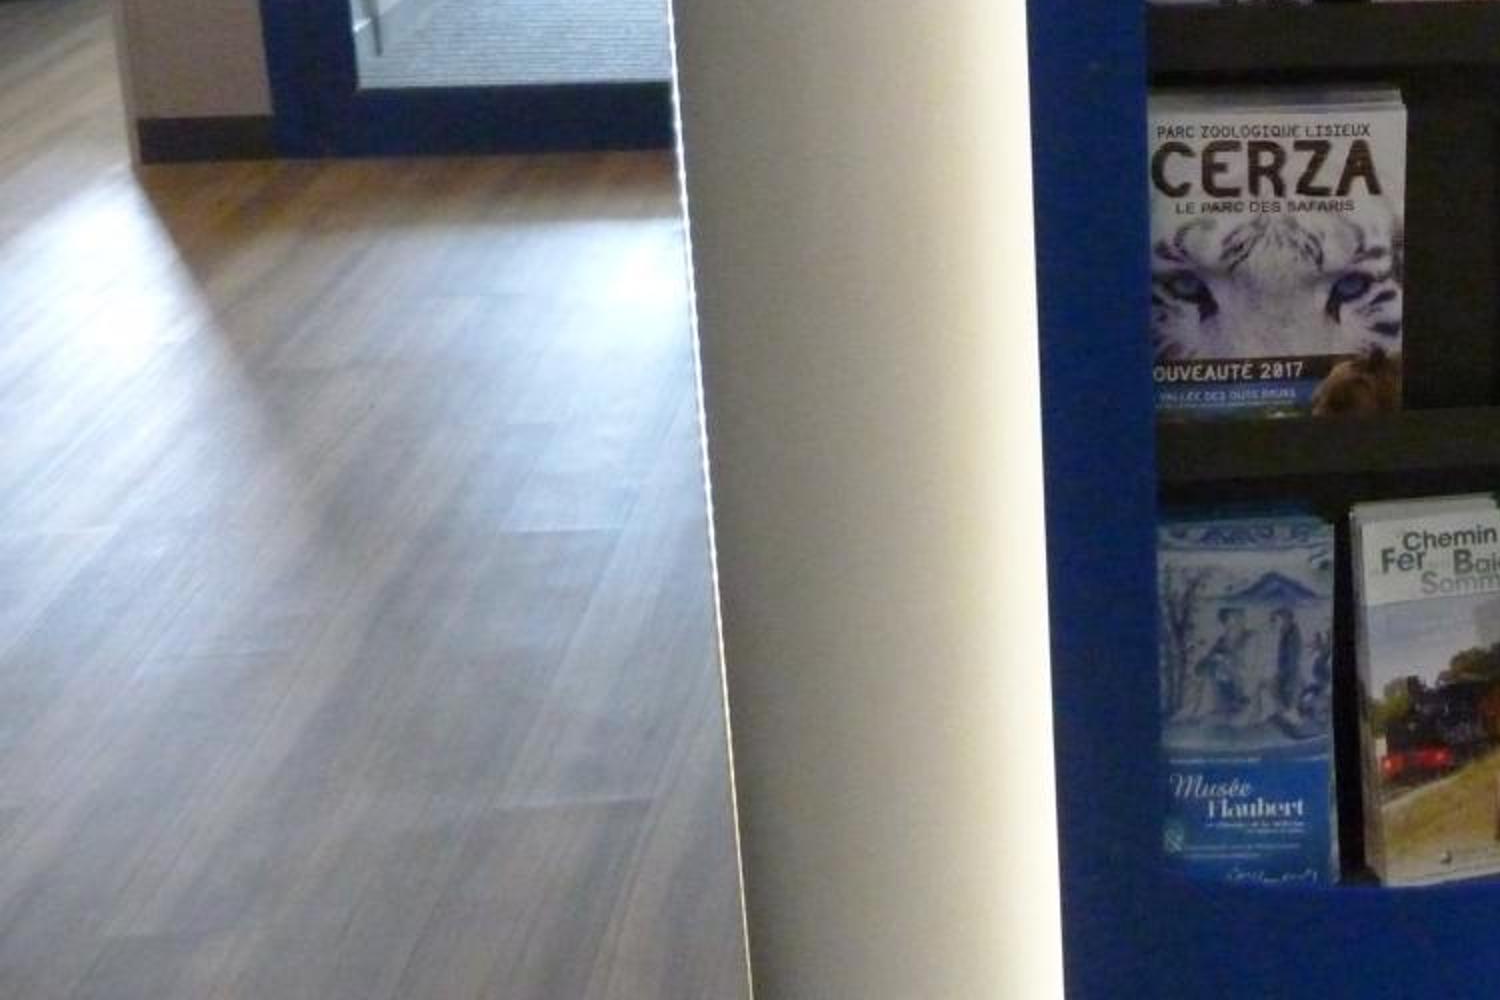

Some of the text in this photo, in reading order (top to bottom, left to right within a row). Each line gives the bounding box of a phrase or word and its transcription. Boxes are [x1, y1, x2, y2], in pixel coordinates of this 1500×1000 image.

[1157, 123, 1371, 139] PARC ZOOLOGIQUE LISIEUX
[1151, 139, 1382, 198] CERZA
[1176, 199, 1355, 214] LE PARC DES SAFARIS
[1153, 361, 1303, 383] OUVEAUTÉ 2017
[1402, 523, 1498, 551] Chemin
[1380, 547, 1426, 574] Fer
[1169, 774, 1252, 799] Musée
